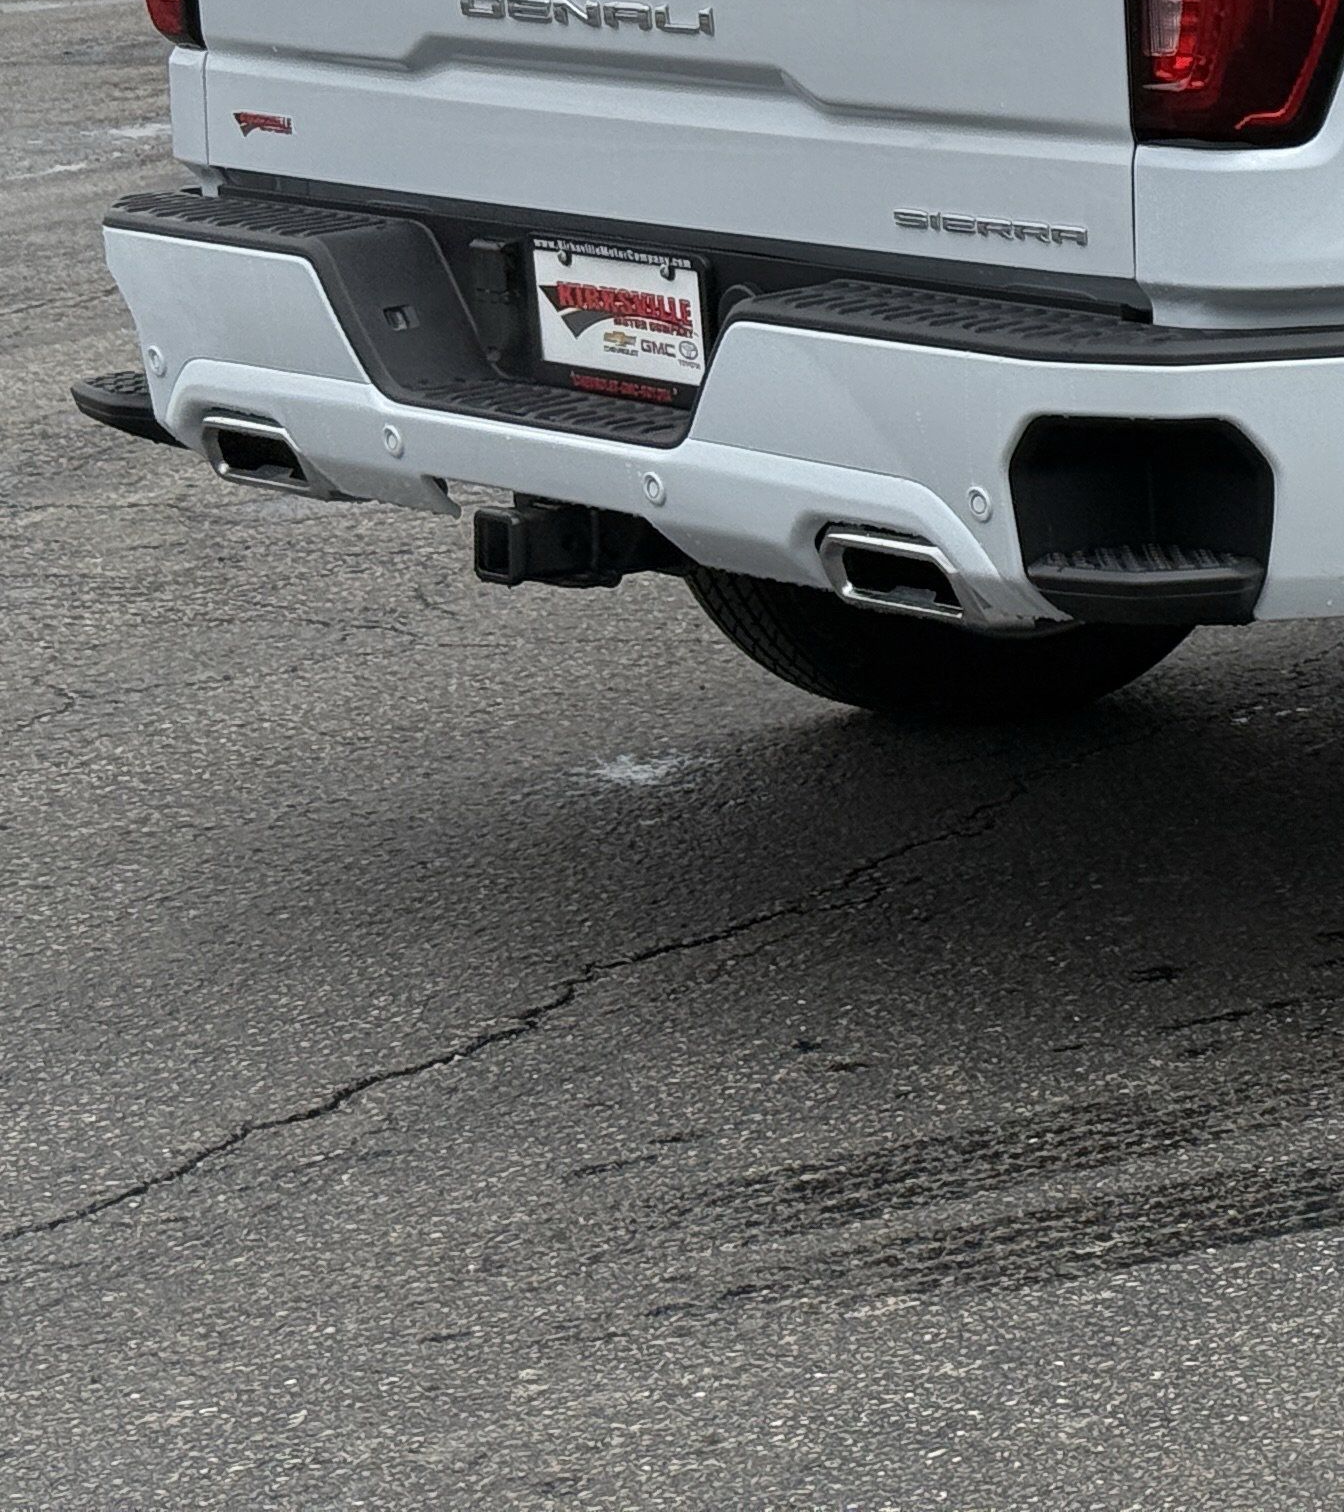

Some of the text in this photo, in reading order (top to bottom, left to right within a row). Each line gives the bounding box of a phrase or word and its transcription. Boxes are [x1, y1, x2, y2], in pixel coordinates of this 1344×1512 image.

[893, 206, 1089, 248] SIERRA
[556, 281, 693, 329] KIRKSVILLE
[613, 317, 694, 338] MOTOR COMPANY
[641, 339, 676, 358] GMC
